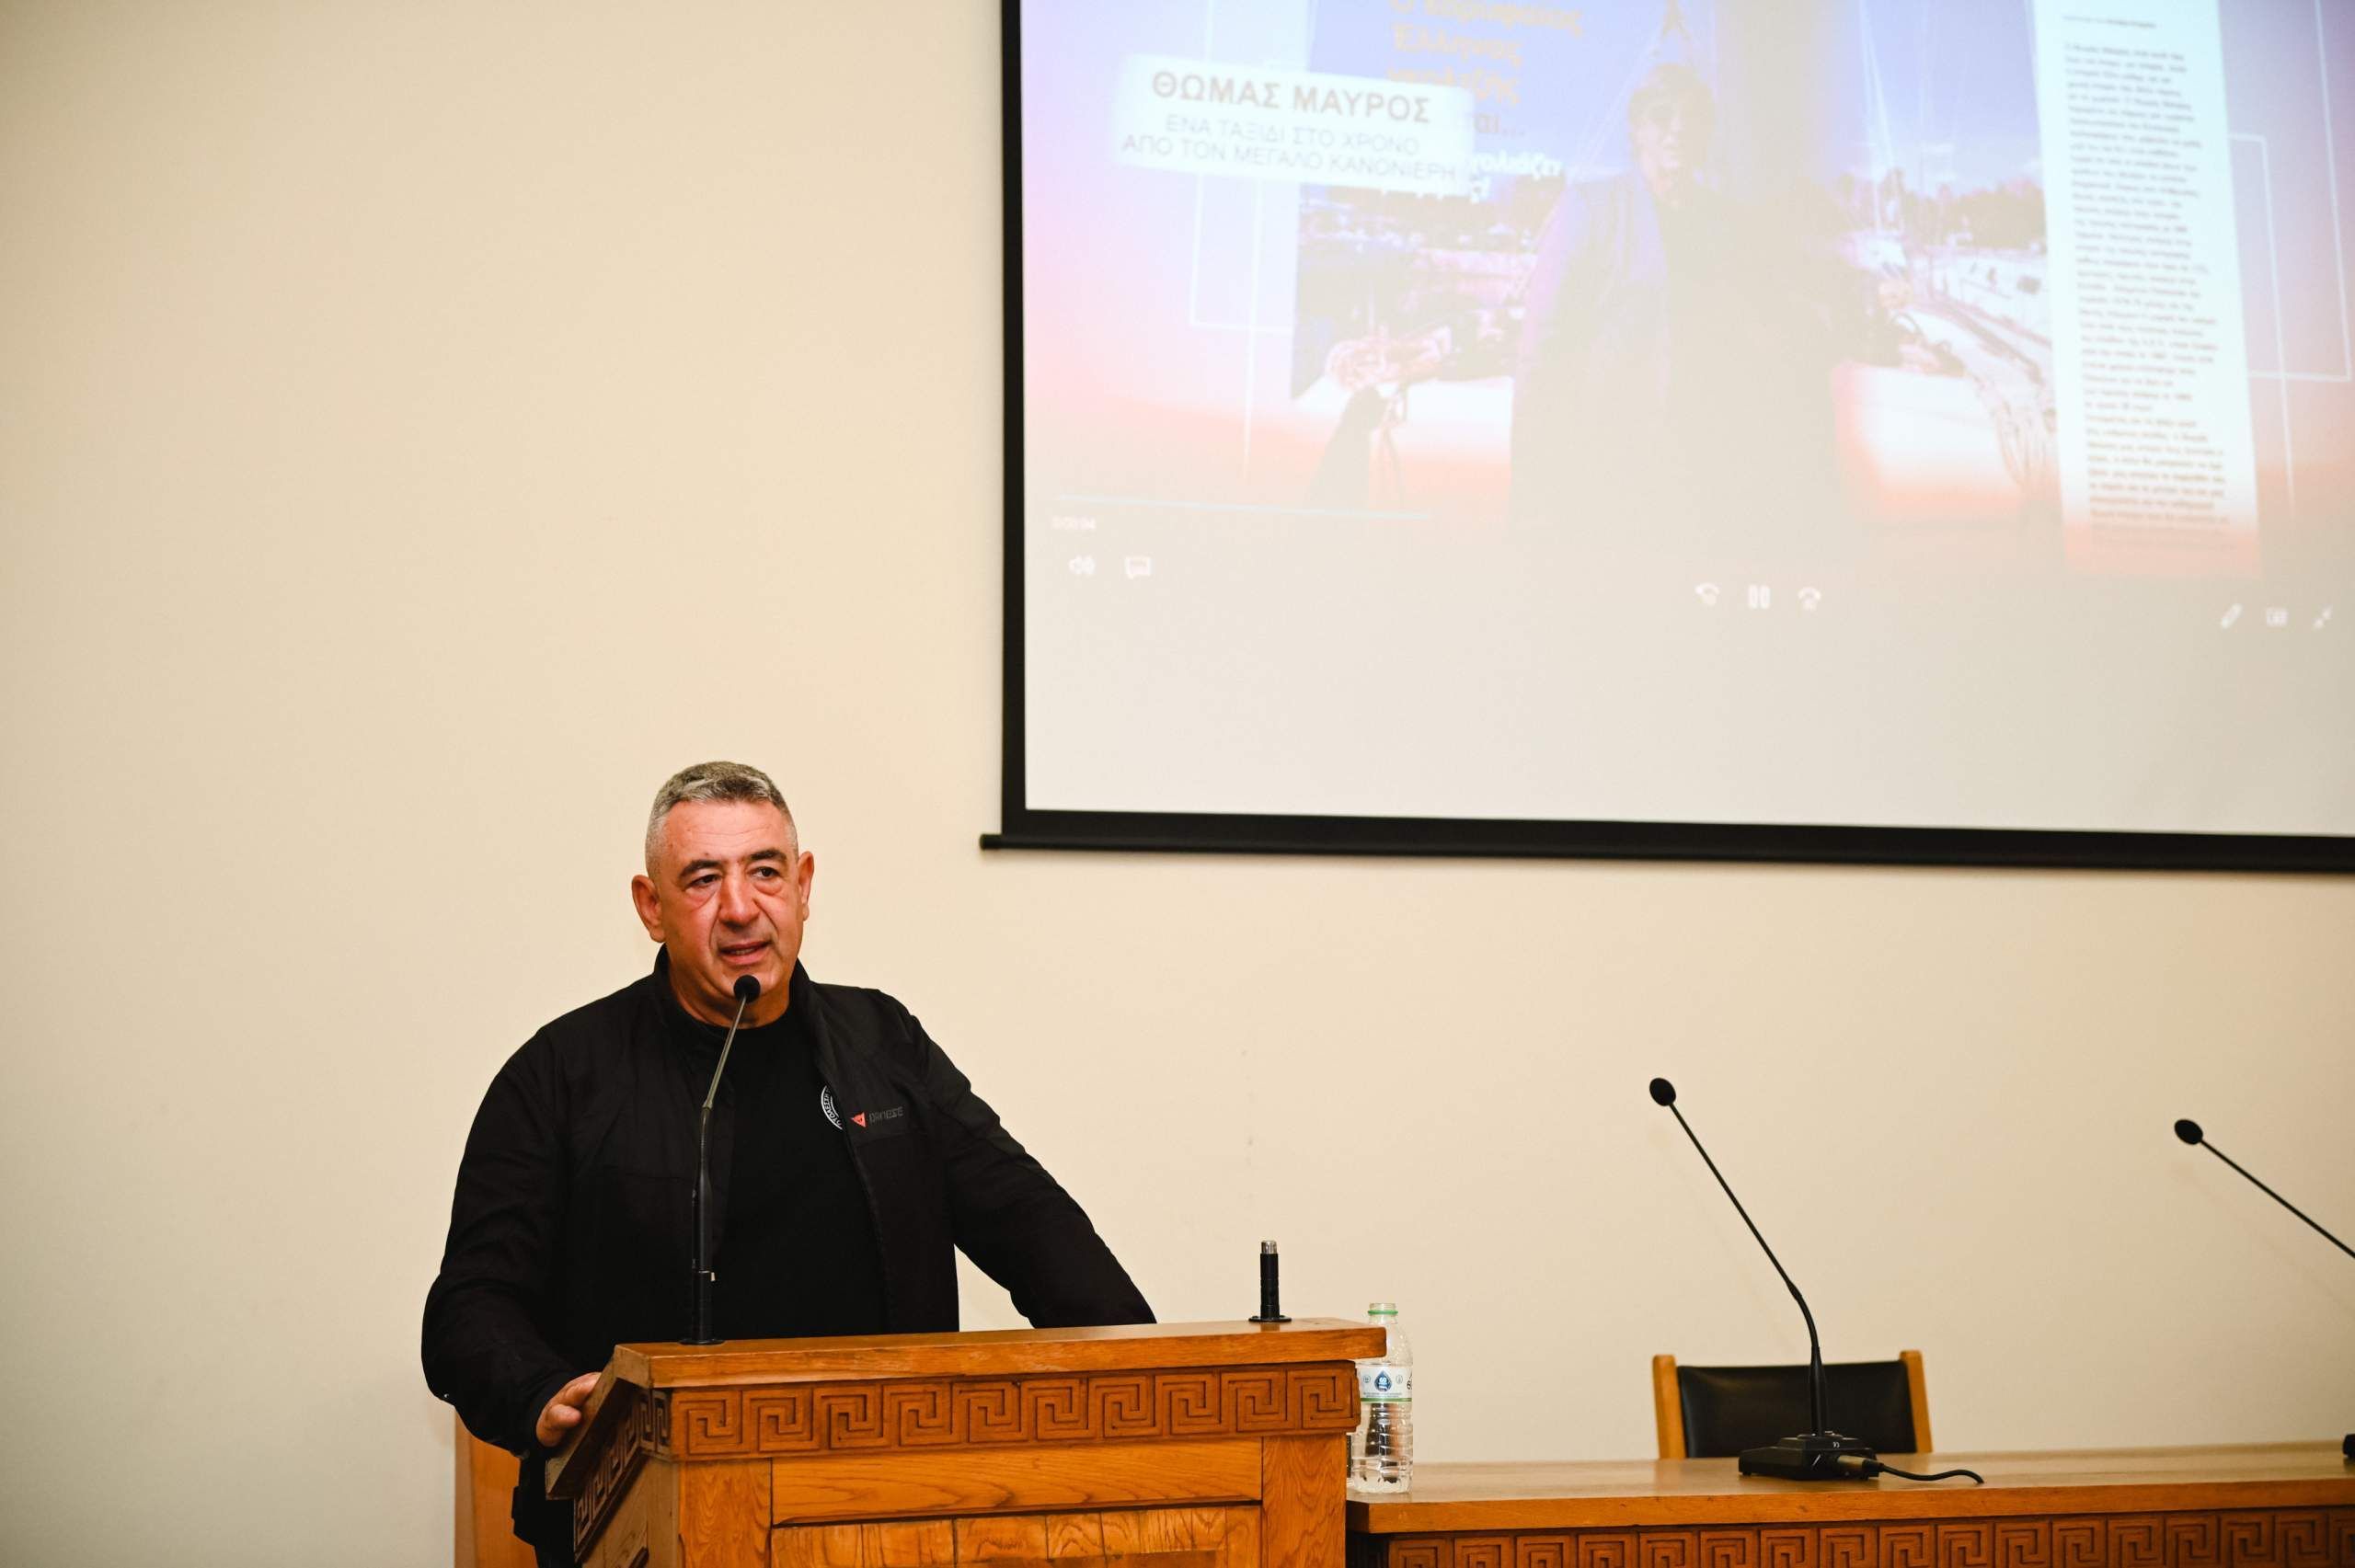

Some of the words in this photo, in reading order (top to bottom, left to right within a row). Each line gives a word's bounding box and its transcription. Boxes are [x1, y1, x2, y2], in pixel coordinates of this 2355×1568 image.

[1151, 68, 1281, 109] ΘΩΜΑΣ
[1292, 84, 1432, 124] ΜΑΥΡΟΣ
[1120, 133, 1174, 156] ΑΠΟ
[1180, 138, 1226, 163] ΤΟΝ
[1234, 144, 1324, 171] ΜΕΓΑΛΟ
[1328, 154, 1457, 182] ΚΑΝΟΝΙΕΡΗ
[1164, 112, 1212, 135] ΕΝΑ
[1217, 118, 1285, 143] ΤΑΞΙΔΙ
[1292, 125, 1336, 149] ΣΤΟ
[1341, 131, 1421, 156] ΧΡΟΝΟ
